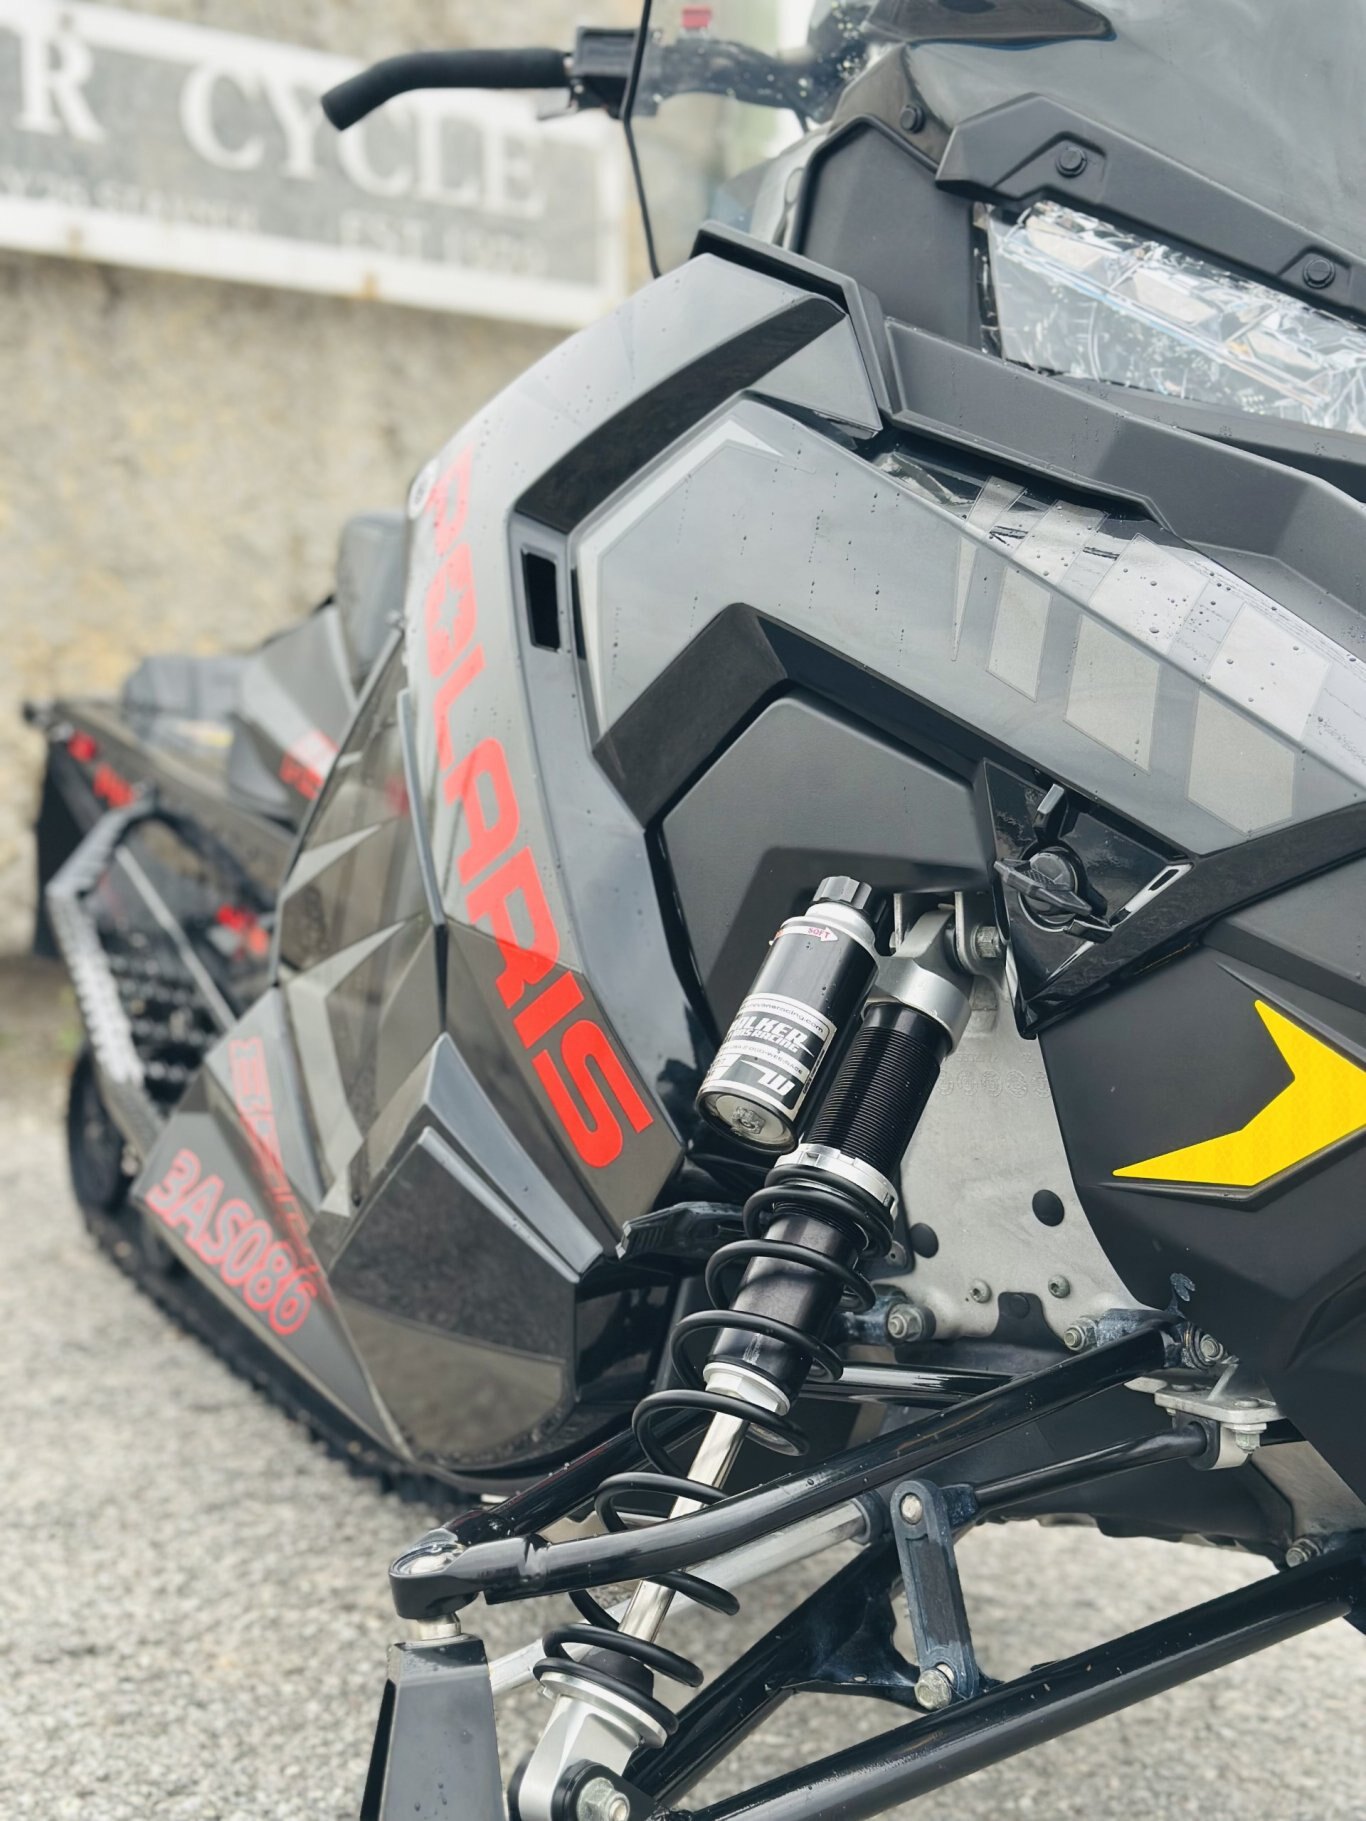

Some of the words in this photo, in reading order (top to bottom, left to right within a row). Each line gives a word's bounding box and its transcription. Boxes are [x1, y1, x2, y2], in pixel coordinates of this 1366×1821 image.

[178, 58, 548, 219] CYCLE
[422, 441, 654, 1168] POLARIS
[807, 926, 831, 939] SOFT
[144, 1148, 318, 1335] 3AS086
